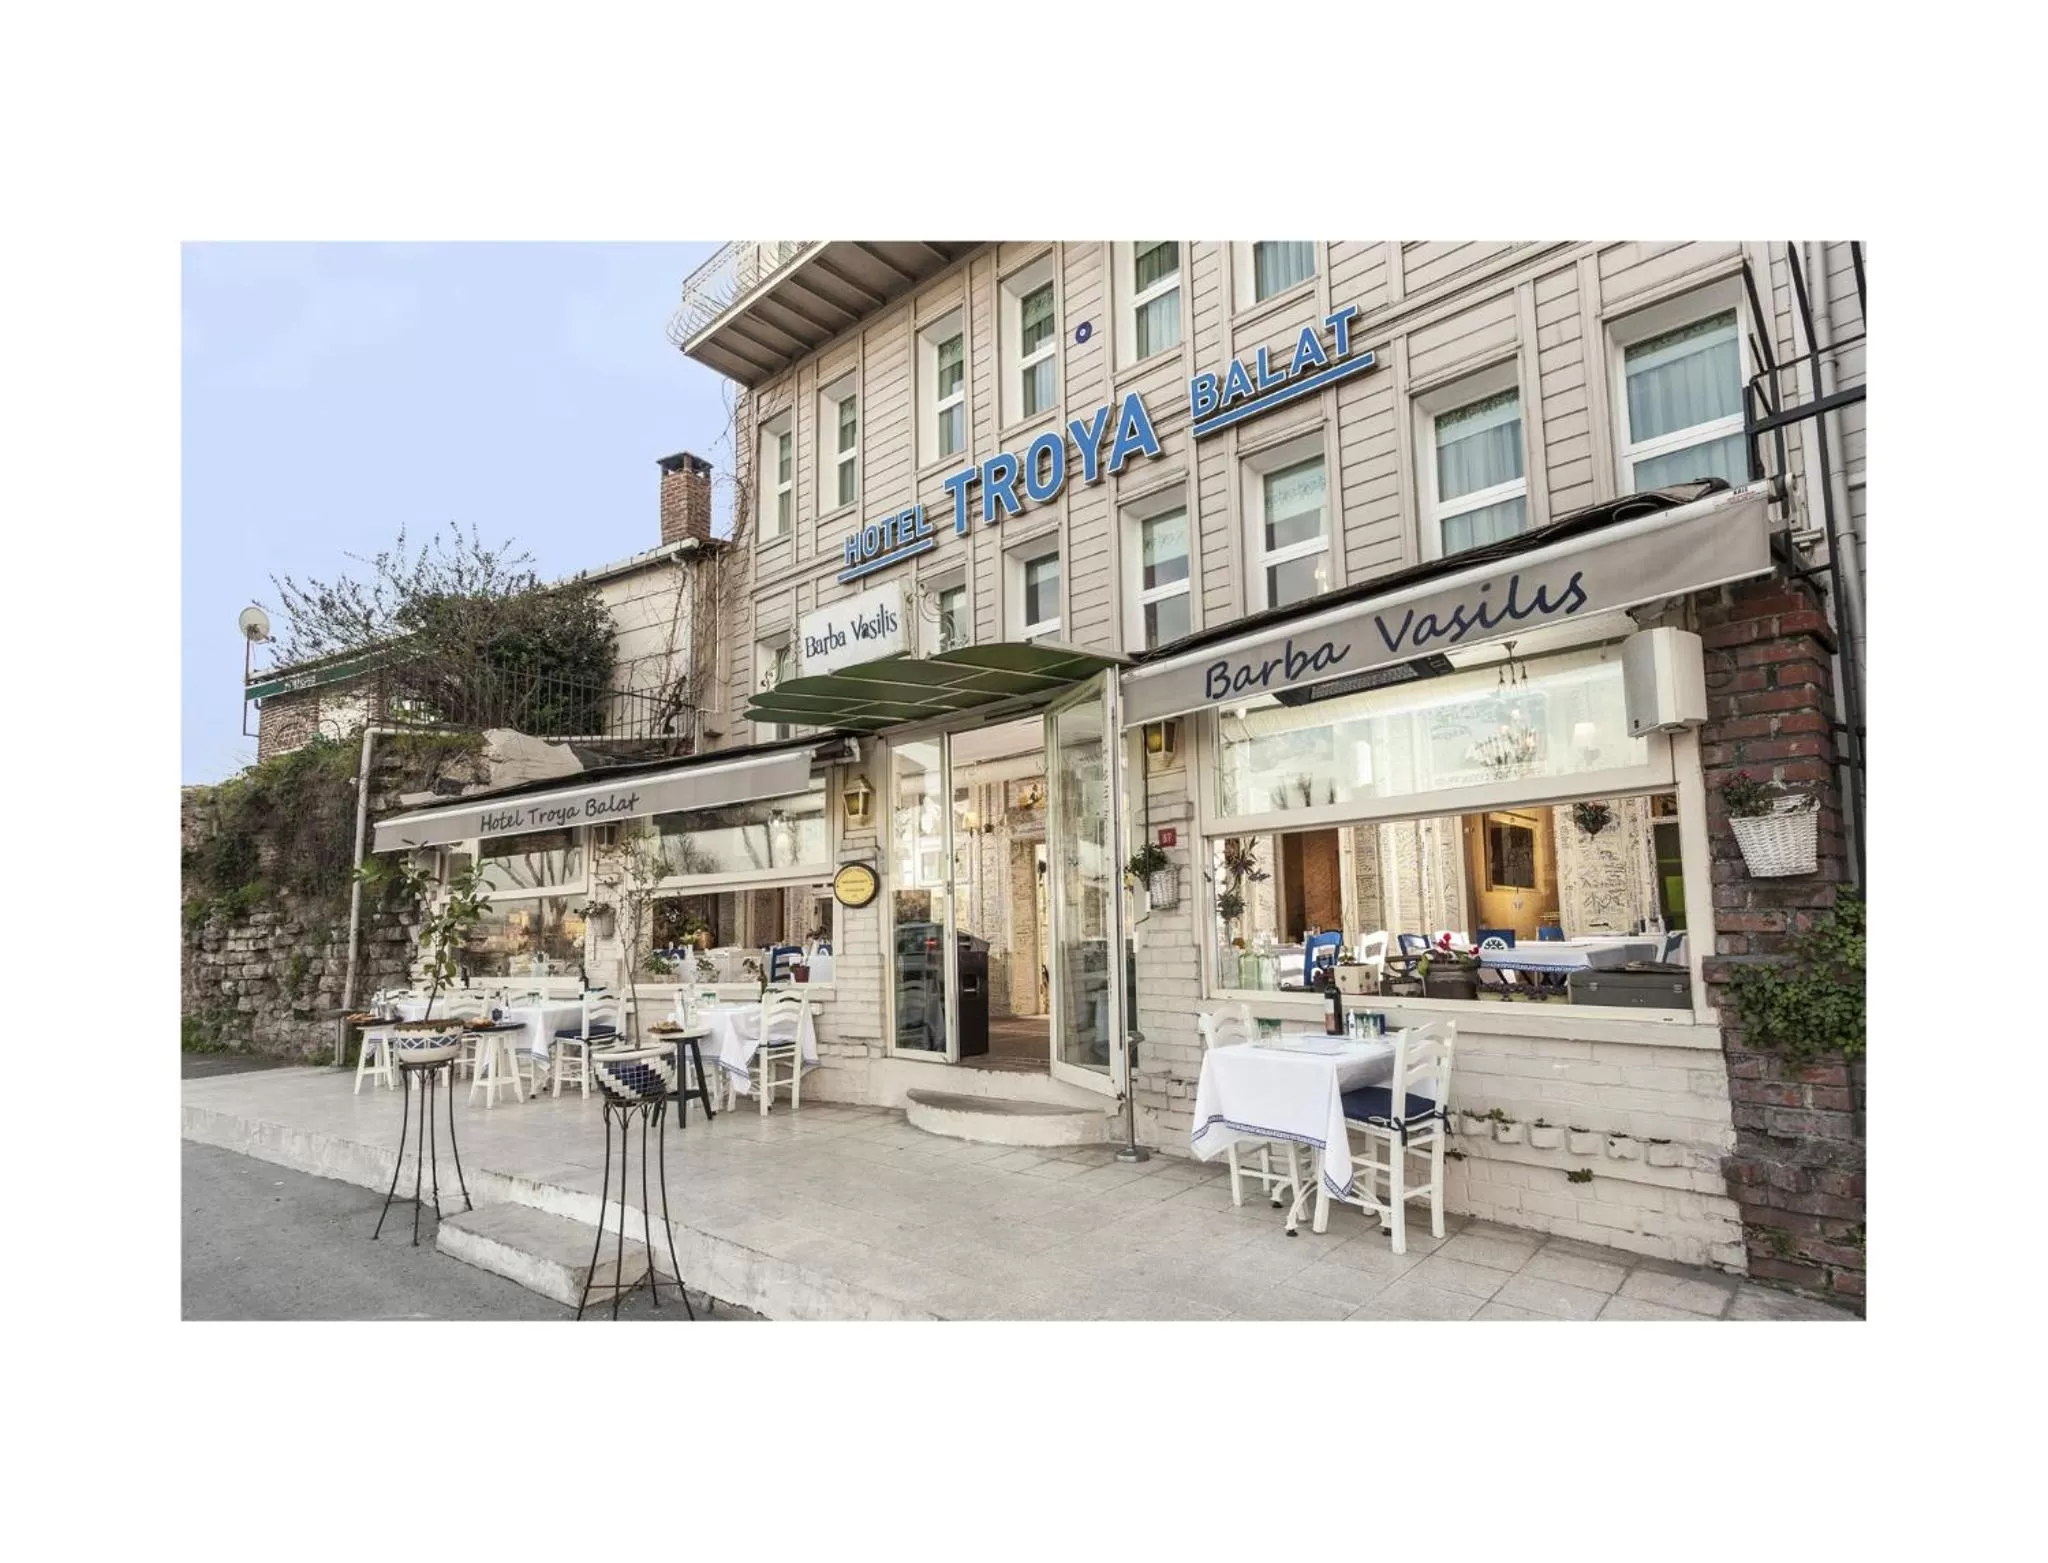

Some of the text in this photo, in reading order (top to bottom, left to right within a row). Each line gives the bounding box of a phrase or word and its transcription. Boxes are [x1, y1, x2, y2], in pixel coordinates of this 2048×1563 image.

[844, 304, 1358, 564] HOTEL TROYA BALAT
[805, 604, 897, 658] Barba Vasilis
[1206, 641, 1351, 699] Barba
[480, 793, 640, 832] Hotel Troya Balat
